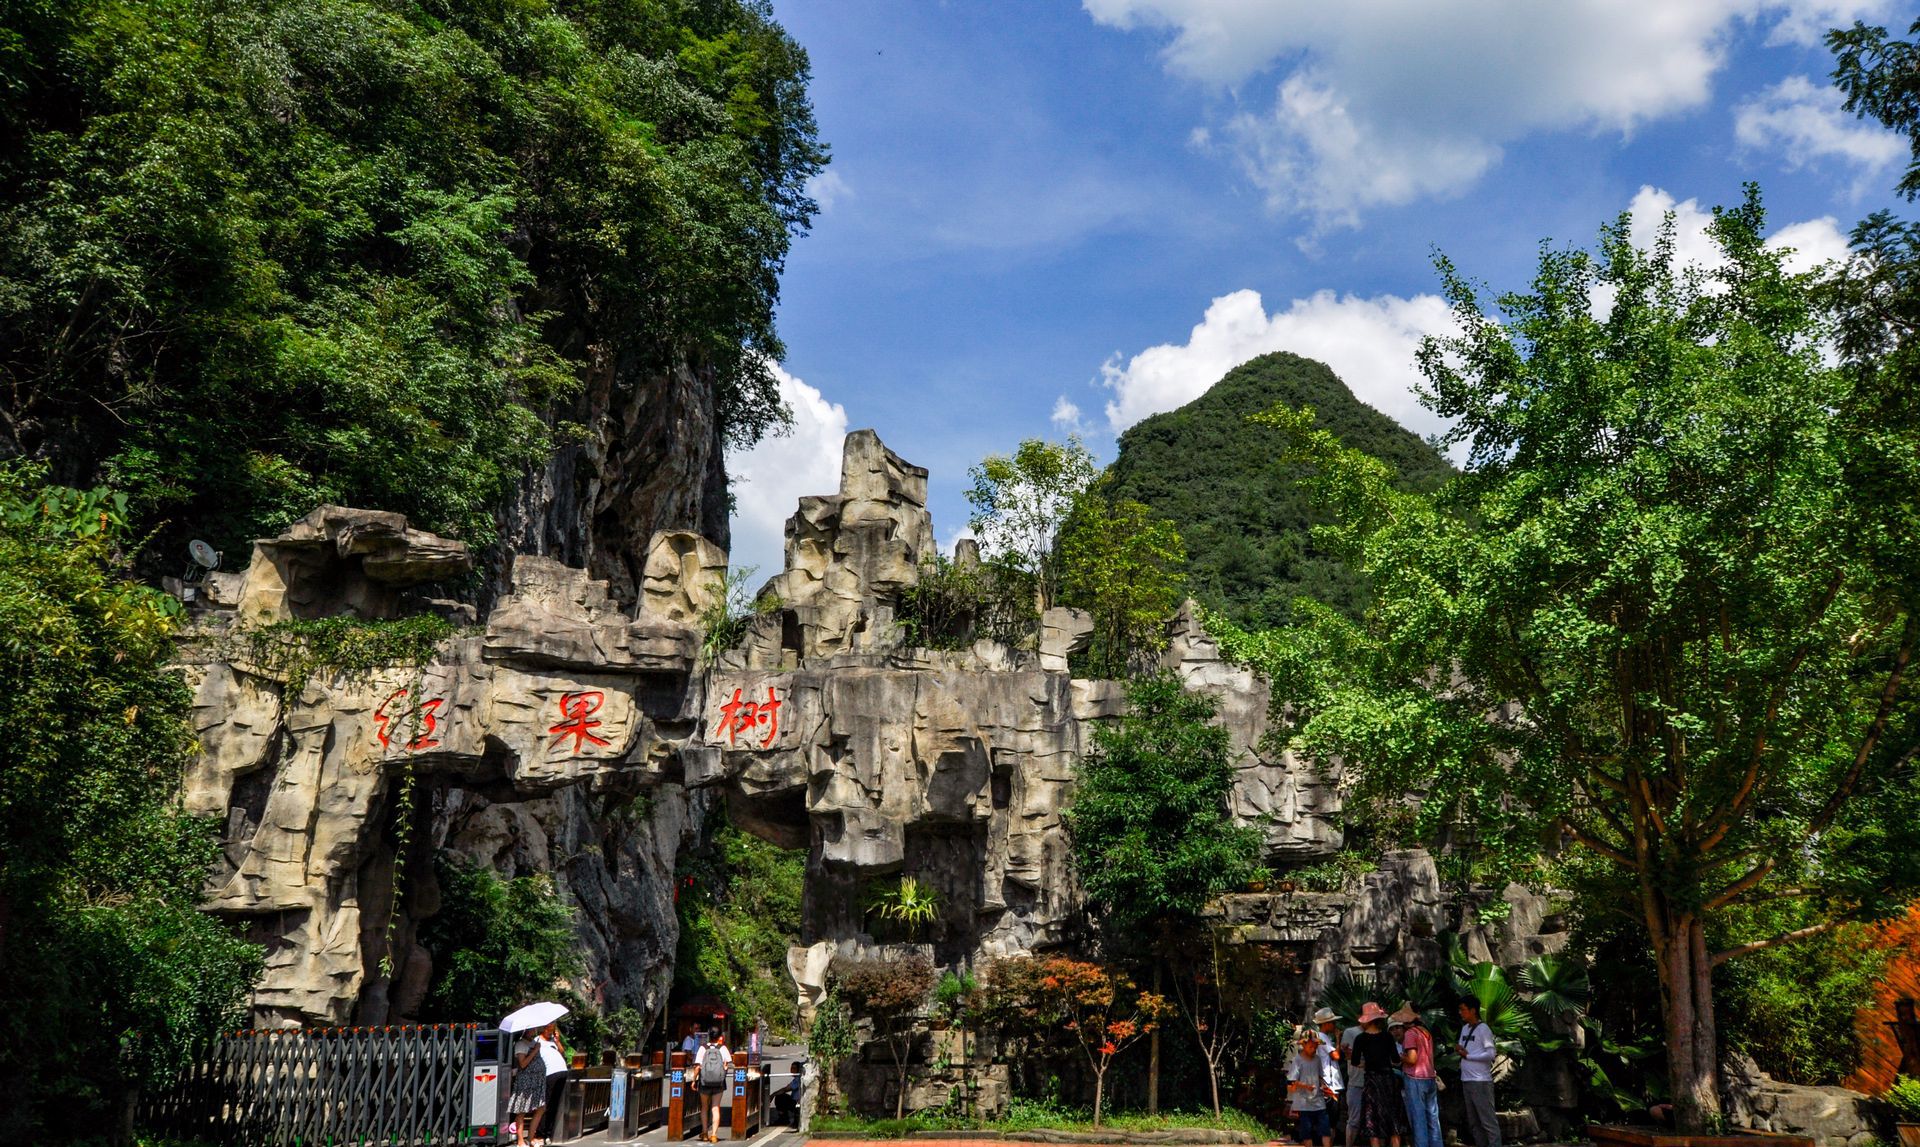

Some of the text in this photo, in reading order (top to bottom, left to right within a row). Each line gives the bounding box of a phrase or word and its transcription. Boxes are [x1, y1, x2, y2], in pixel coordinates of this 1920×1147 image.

[373, 686, 783, 753] 红果树
[671, 1071, 683, 1097] 进口
[735, 1070, 746, 1096] 进口
